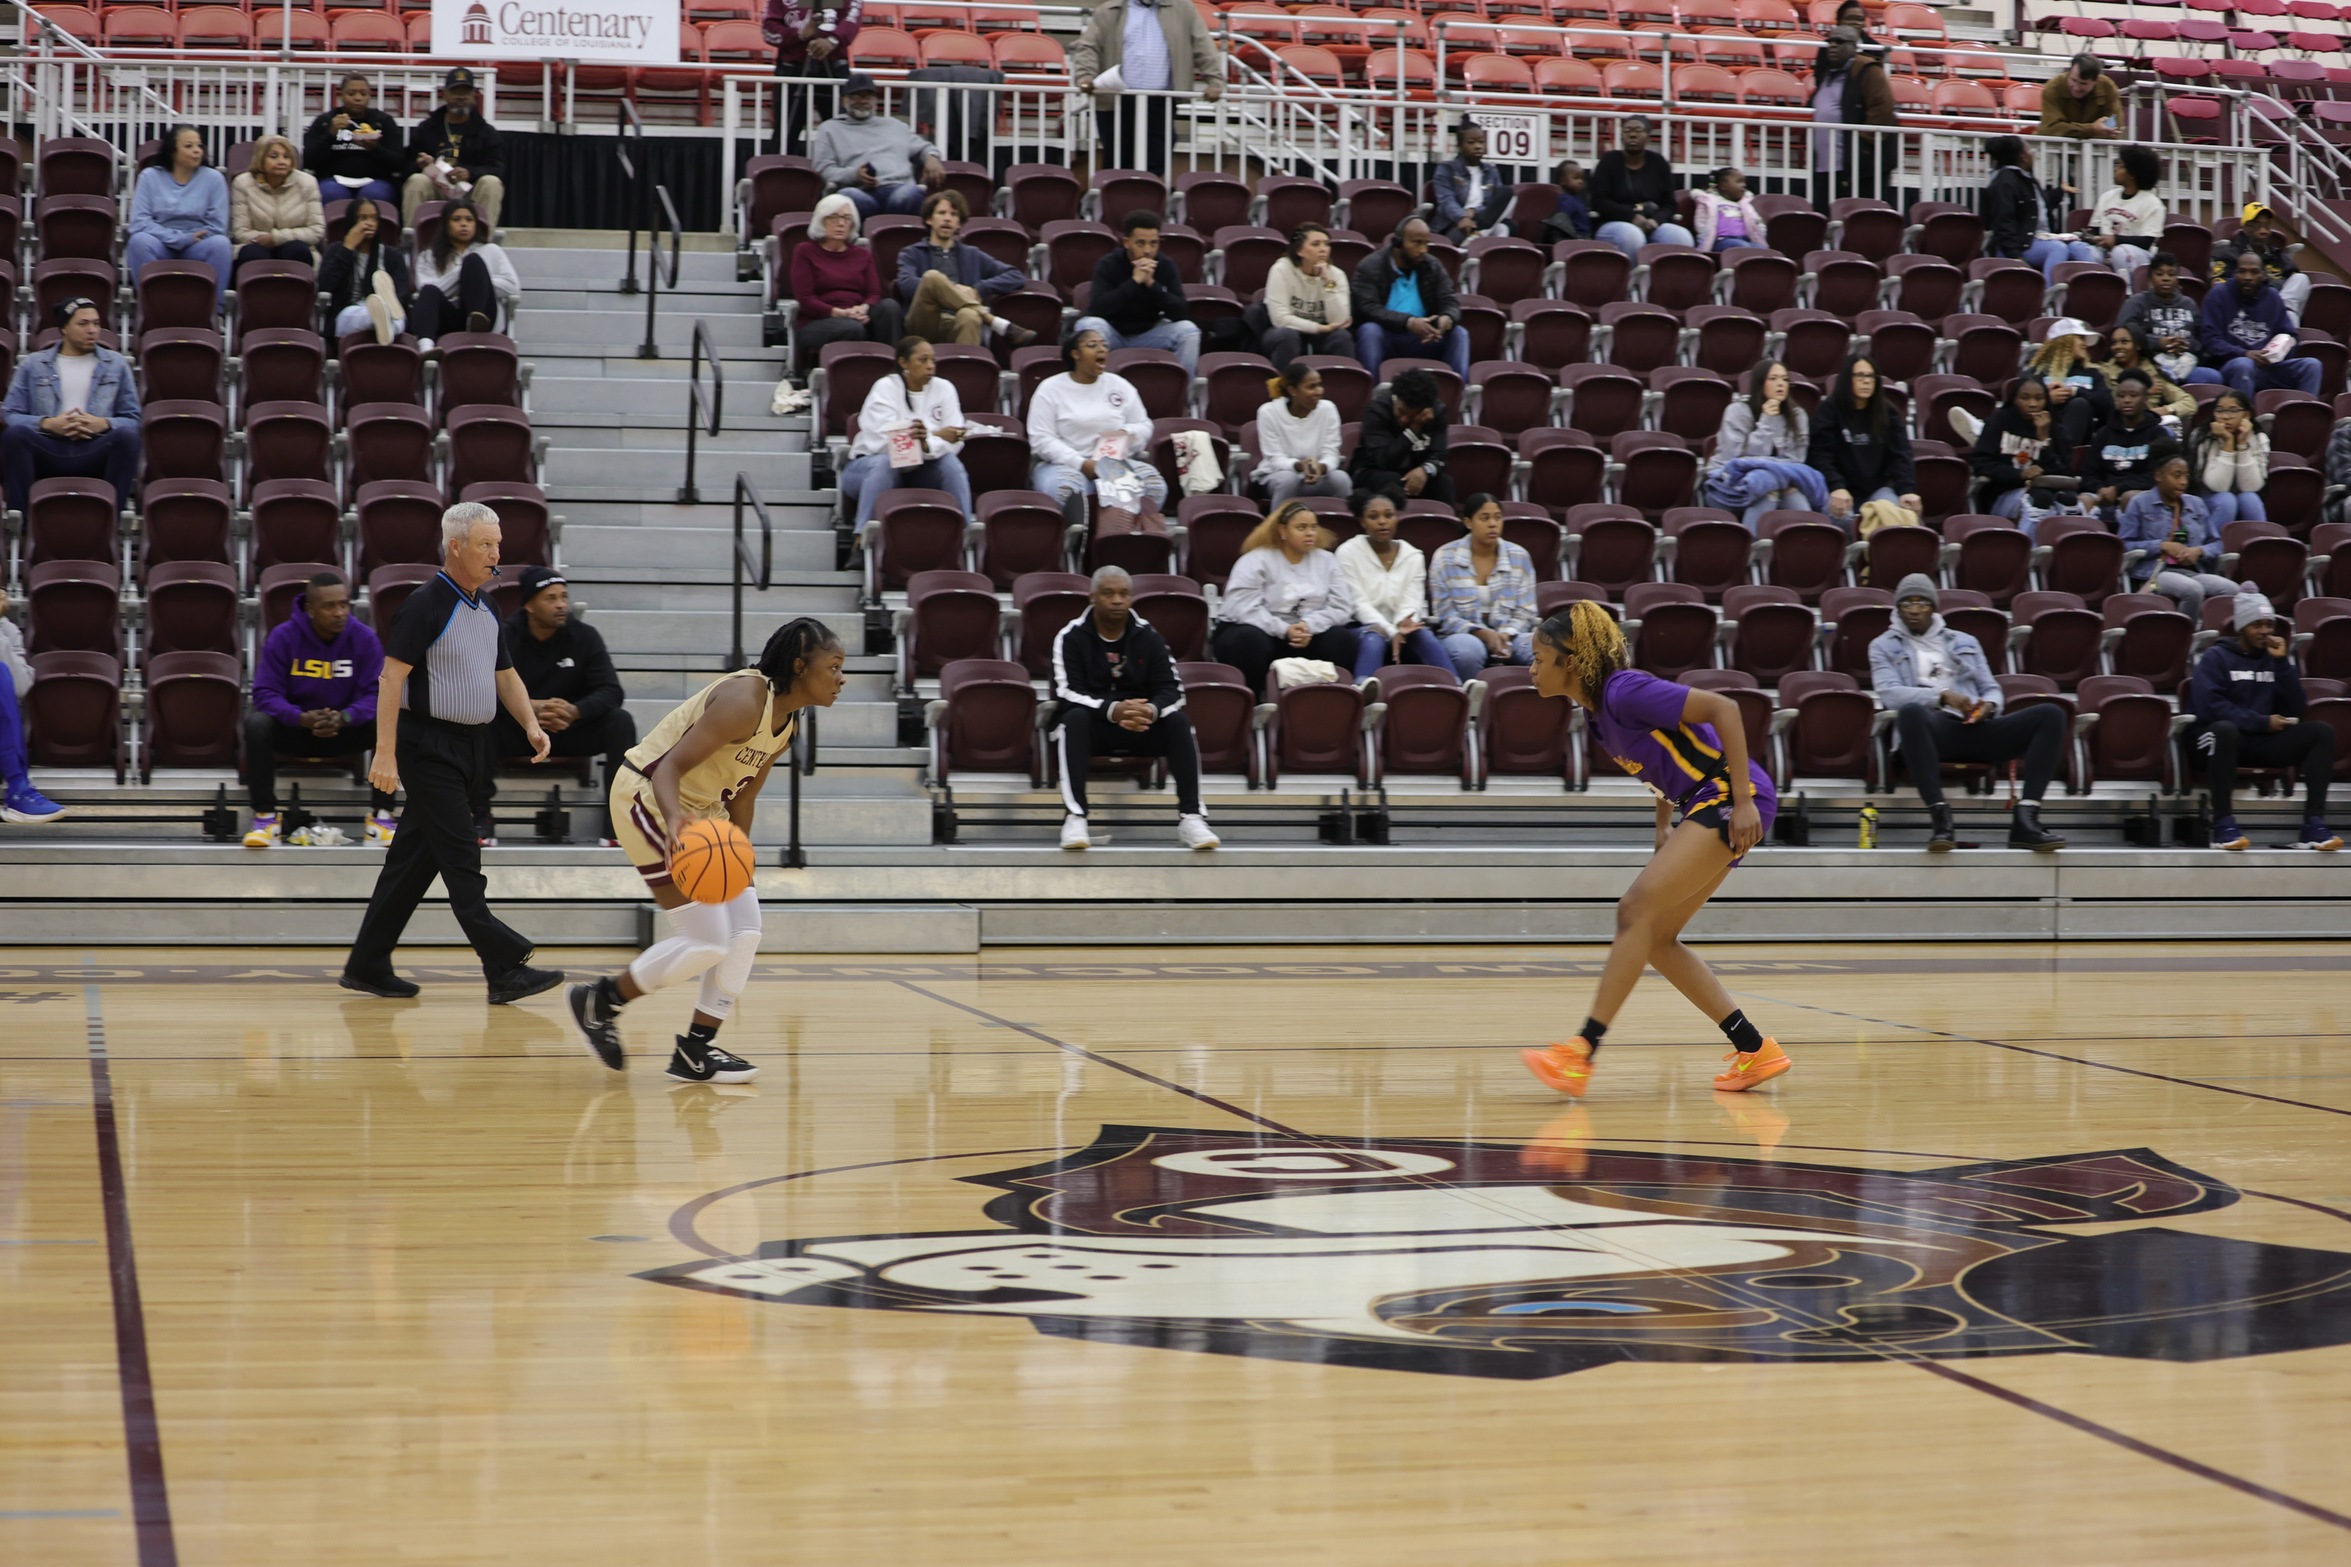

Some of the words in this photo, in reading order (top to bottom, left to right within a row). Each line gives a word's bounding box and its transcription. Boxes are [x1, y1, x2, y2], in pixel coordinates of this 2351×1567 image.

[499, 1, 654, 49] Centenary
[500, 37, 551, 47] COLLEGE
[554, 38, 571, 47] OF
[572, 38, 633, 49] LOUISIANA
[1477, 116, 1531, 129] SECTION
